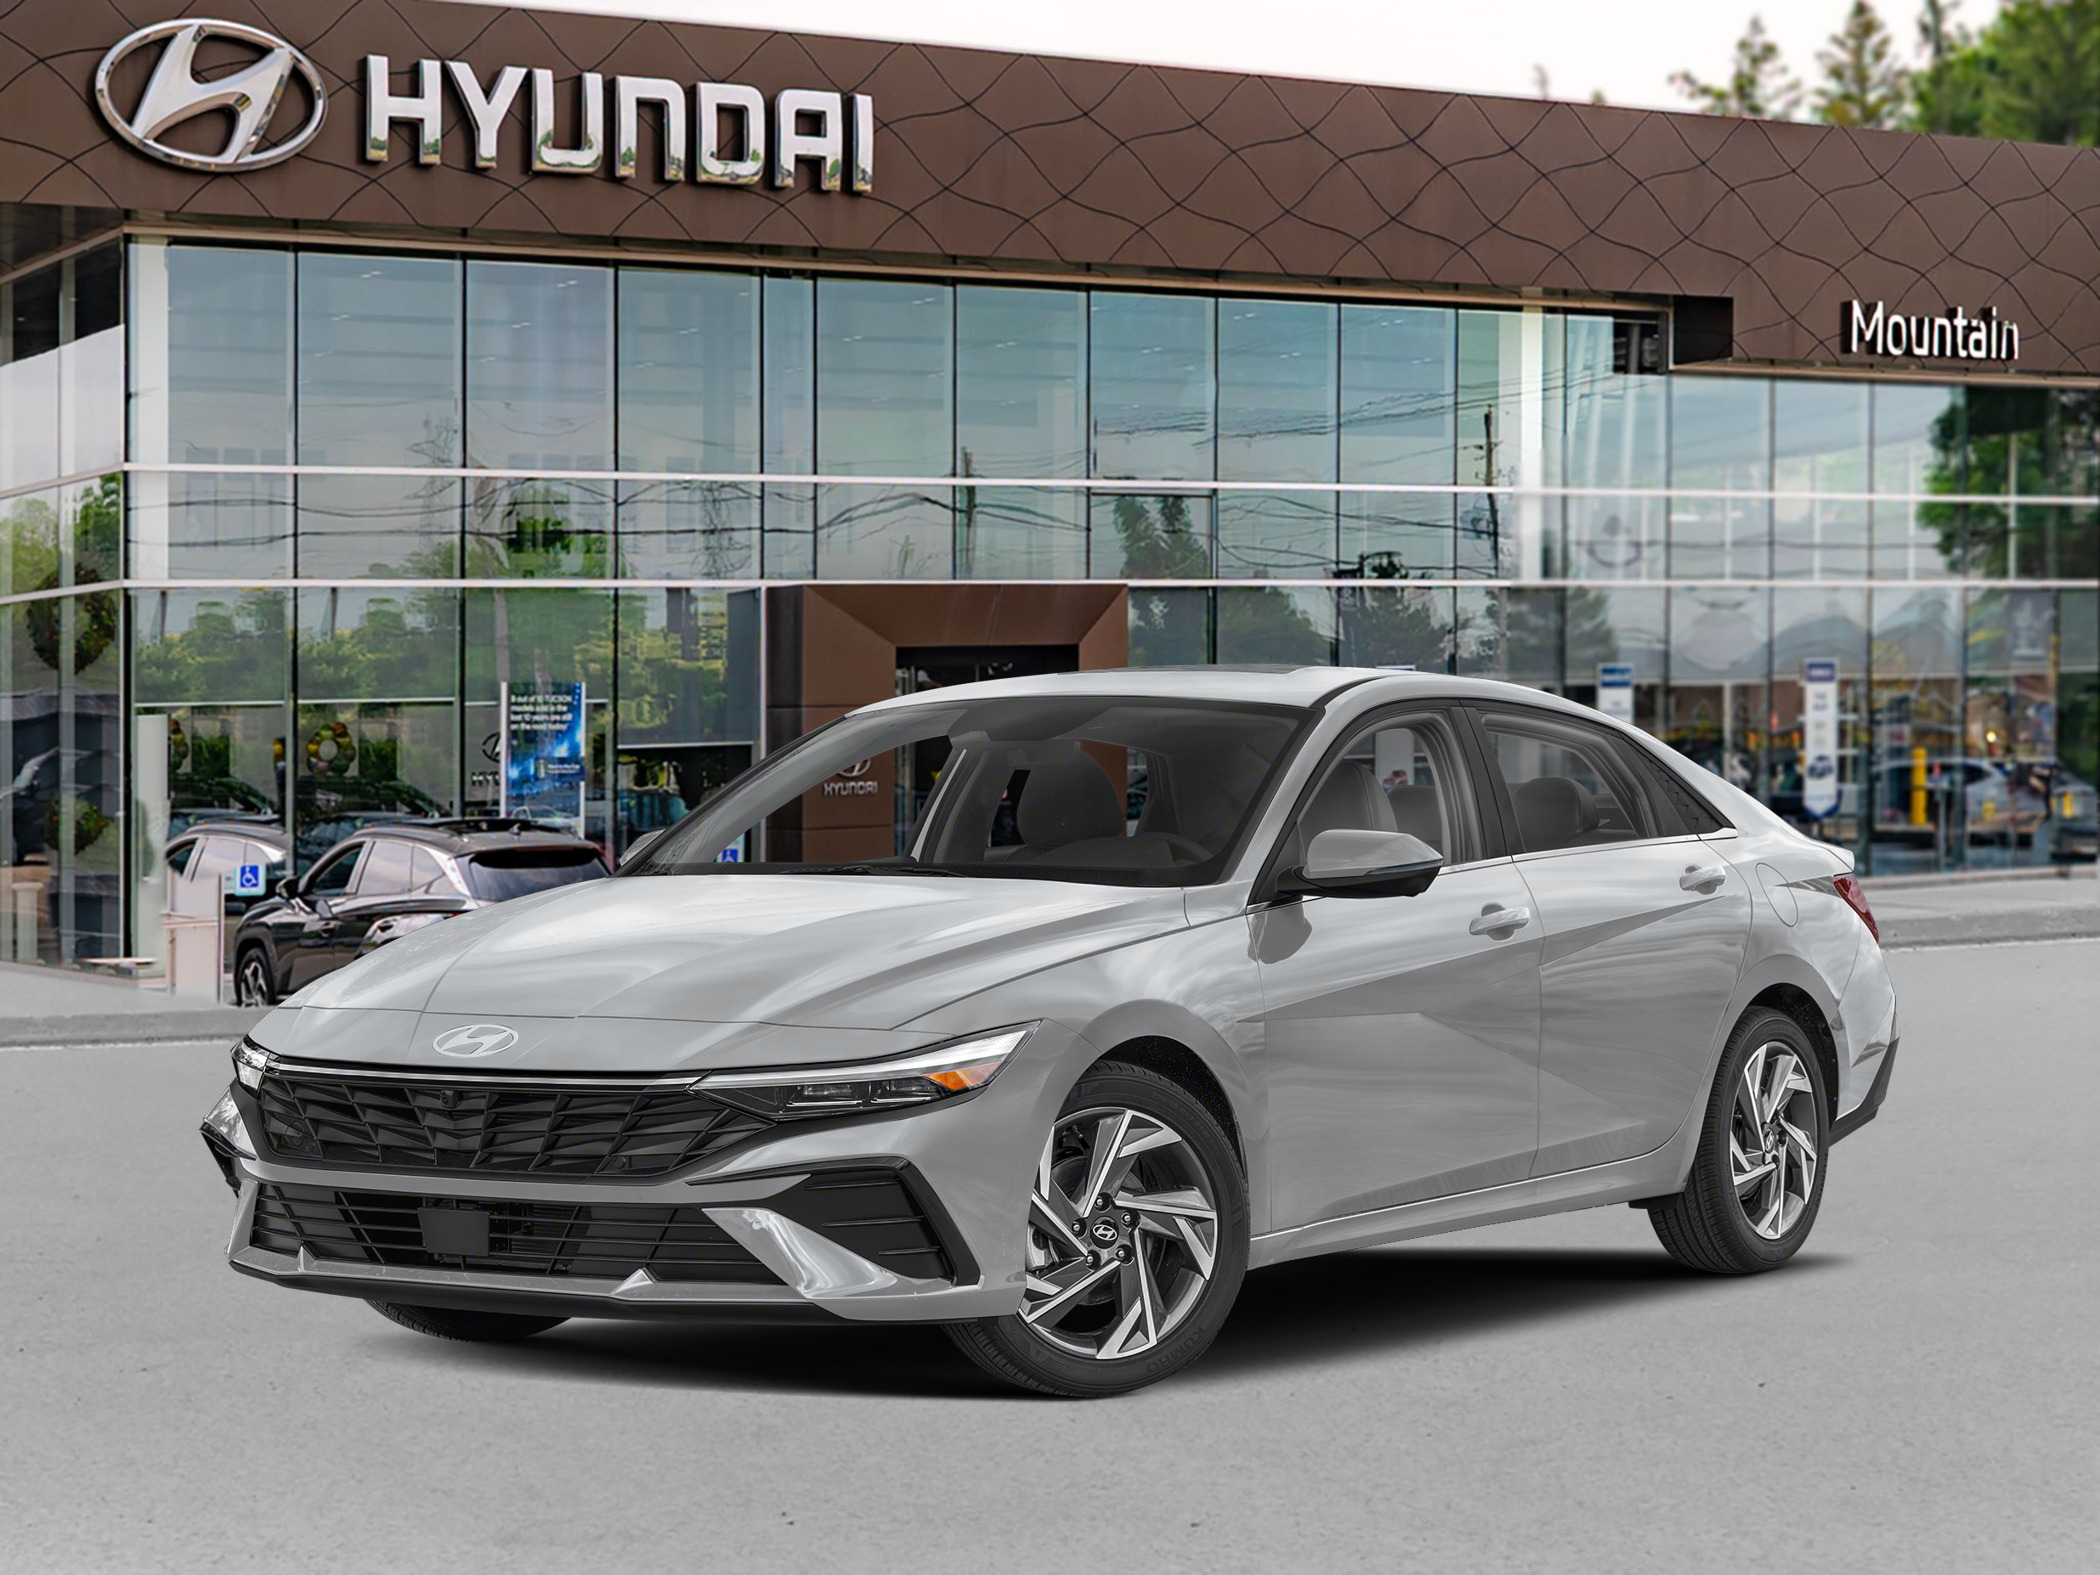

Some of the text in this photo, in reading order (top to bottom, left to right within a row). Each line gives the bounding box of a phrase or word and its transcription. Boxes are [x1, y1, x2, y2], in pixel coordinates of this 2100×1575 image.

[365, 54, 874, 193] HYUNDAI
[1851, 299, 2019, 360] Mountain
[823, 781, 878, 796] HYUNDAI
[1146, 1326, 1207, 1372] KUMHO
